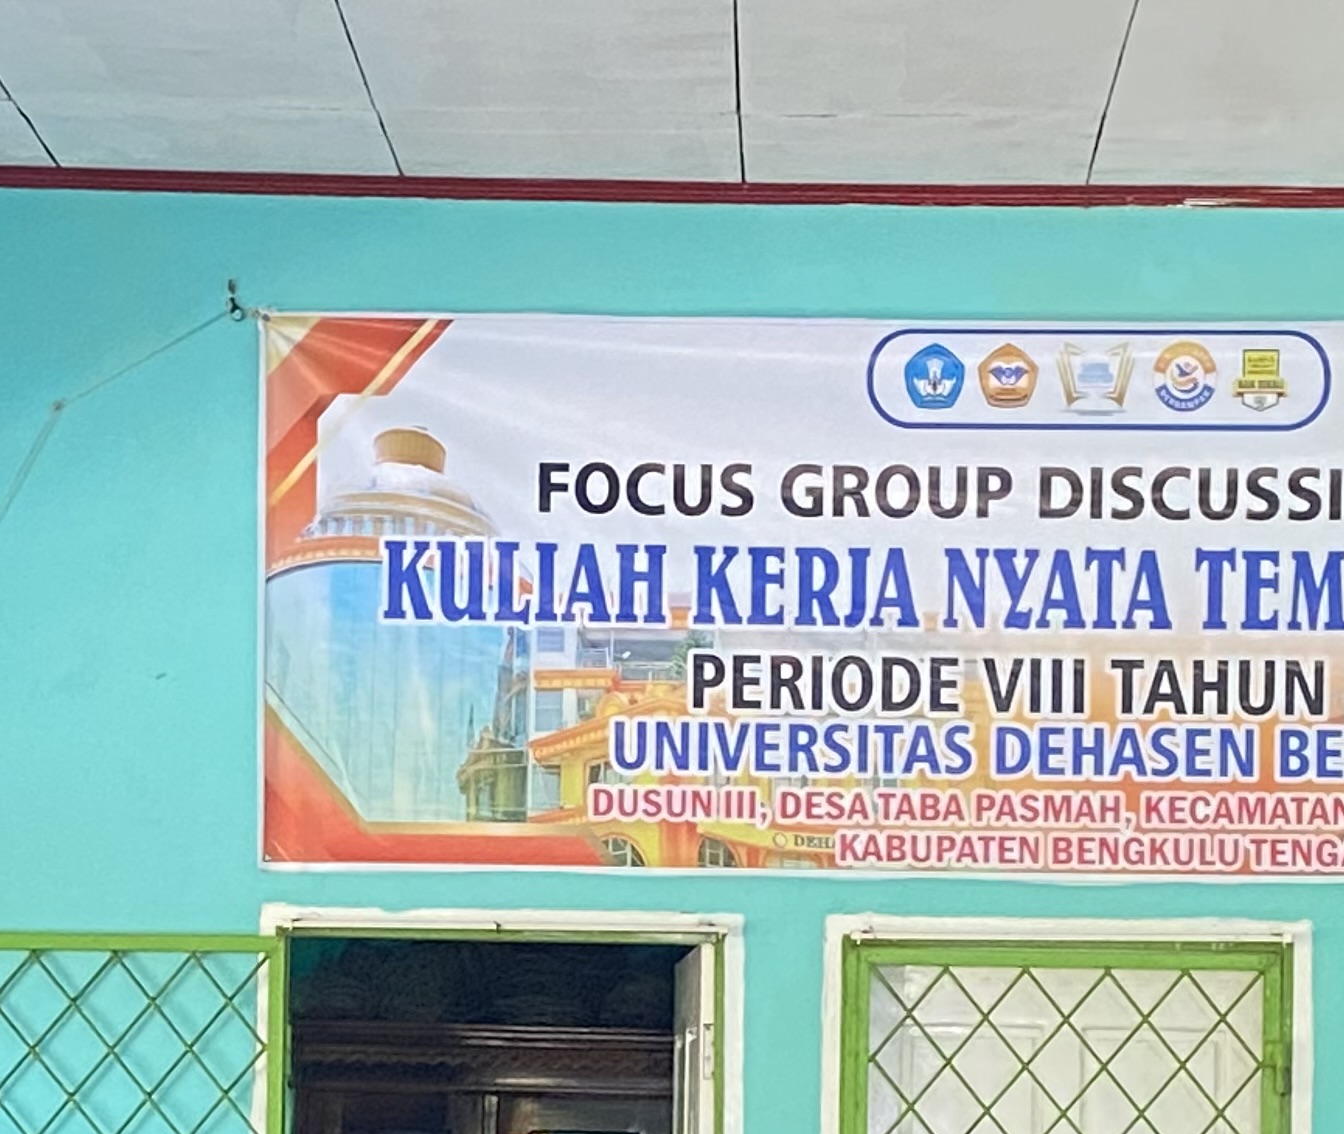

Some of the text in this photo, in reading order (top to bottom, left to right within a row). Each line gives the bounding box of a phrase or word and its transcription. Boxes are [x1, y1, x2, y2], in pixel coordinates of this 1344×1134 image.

[537, 461, 755, 518] FOCUS
[779, 463, 1014, 520] GROUP
[383, 539, 668, 626] KULIAH
[692, 545, 921, 629] KERJA
[943, 546, 1173, 631] NYATA
[691, 653, 960, 713] PERIODE
[982, 657, 1086, 715] VIII
[1110, 658, 1325, 717] TAHUN
[613, 720, 973, 776] UNIVERSITAS
[995, 726, 1255, 778] DEHASEN
[592, 787, 713, 819] DUSUN
[780, 790, 870, 821] DESA
[877, 792, 965, 823] TABA
[975, 793, 1133, 830] PASMAH,
[839, 833, 1041, 865] KABUPATEN
[1052, 836, 1241, 868] BENGKULU
